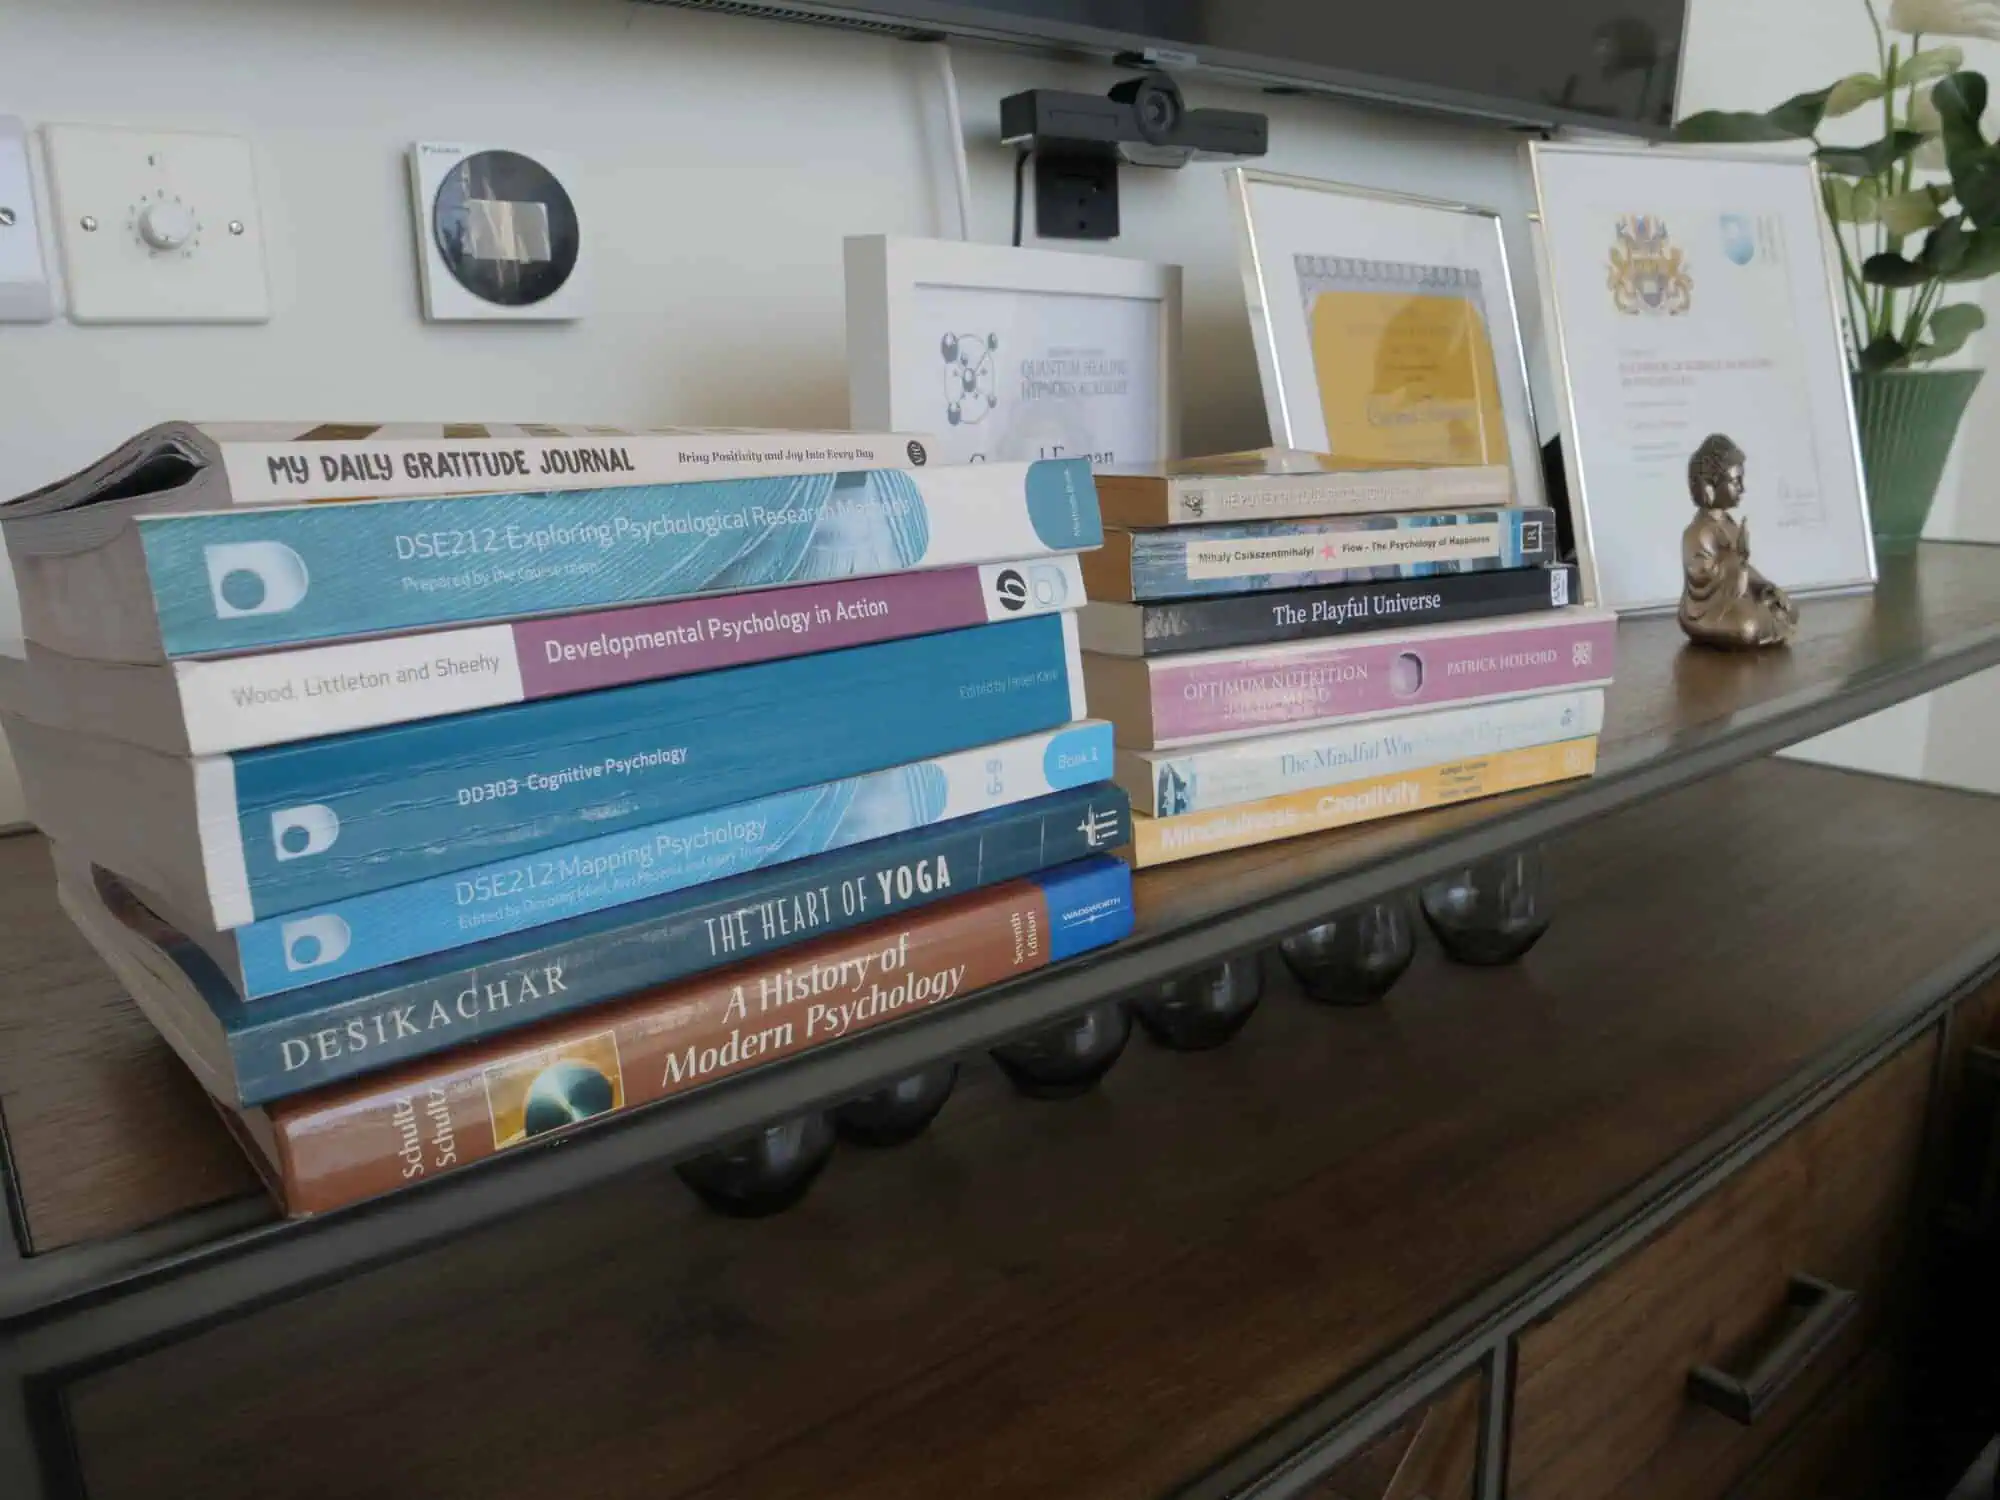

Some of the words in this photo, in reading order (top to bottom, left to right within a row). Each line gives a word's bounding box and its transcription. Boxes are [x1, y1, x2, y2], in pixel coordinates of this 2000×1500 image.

[267, 455, 309, 484] MY
[319, 454, 394, 482] DAILY
[403, 450, 531, 479] GRATITUDE
[540, 447, 636, 475] JOURNAL
[678, 451, 709, 464] Bring
[712, 450, 763, 463] Positivity
[764, 449, 783, 461] and
[785, 449, 803, 462] Joy
[855, 449, 874, 460] Day
[395, 527, 499, 560] DSE212
[507, 521, 614, 549] Exploring
[615, 507, 749, 545] Psychological
[751, 499, 834, 526] Research
[1198, 551, 1231, 565] Mihaly
[1371, 540, 1387, 551] The
[1389, 537, 1437, 553] Psychology
[1273, 604, 1307, 627] The
[1312, 597, 1369, 624] Playful
[1373, 590, 1441, 614] Universe
[545, 620, 704, 664] Developmental
[708, 608, 811, 642] Psychology
[815, 604, 831, 625] in
[836, 599, 889, 622] Action
[304, 669, 390, 697] Littleton
[398, 663, 429, 684] and
[435, 654, 500, 678] Sheehy
[1184, 677, 1267, 702] OPTIMUM
[1271, 663, 1369, 690] NUTRITION
[1447, 657, 1497, 677] PATRICK
[458, 777, 519, 806] DD303
[527, 763, 602, 791] Cognitive
[605, 747, 688, 776] Psychology
[1280, 754, 1309, 776] The
[1314, 740, 1380, 770] Mindful
[455, 863, 553, 906] DSE212
[558, 846, 653, 880] Mapping
[656, 817, 768, 857] Psychology
[1062, 896, 1121, 921] WADSWORTH
[1010, 911, 1024, 965] Seventh
[1026, 911, 1039, 957] Edition
[280, 966, 568, 1071] DESIKACHAR
[704, 908, 751, 957] THE
[761, 886, 831, 941] HEART
[842, 876, 867, 917] OF
[877, 855, 952, 906] YOGA
[722, 985, 747, 1025] A
[760, 953, 870, 1012] History
[880, 931, 911, 972] of
[661, 1016, 793, 1088] Modern
[806, 963, 967, 1039] Psychology
